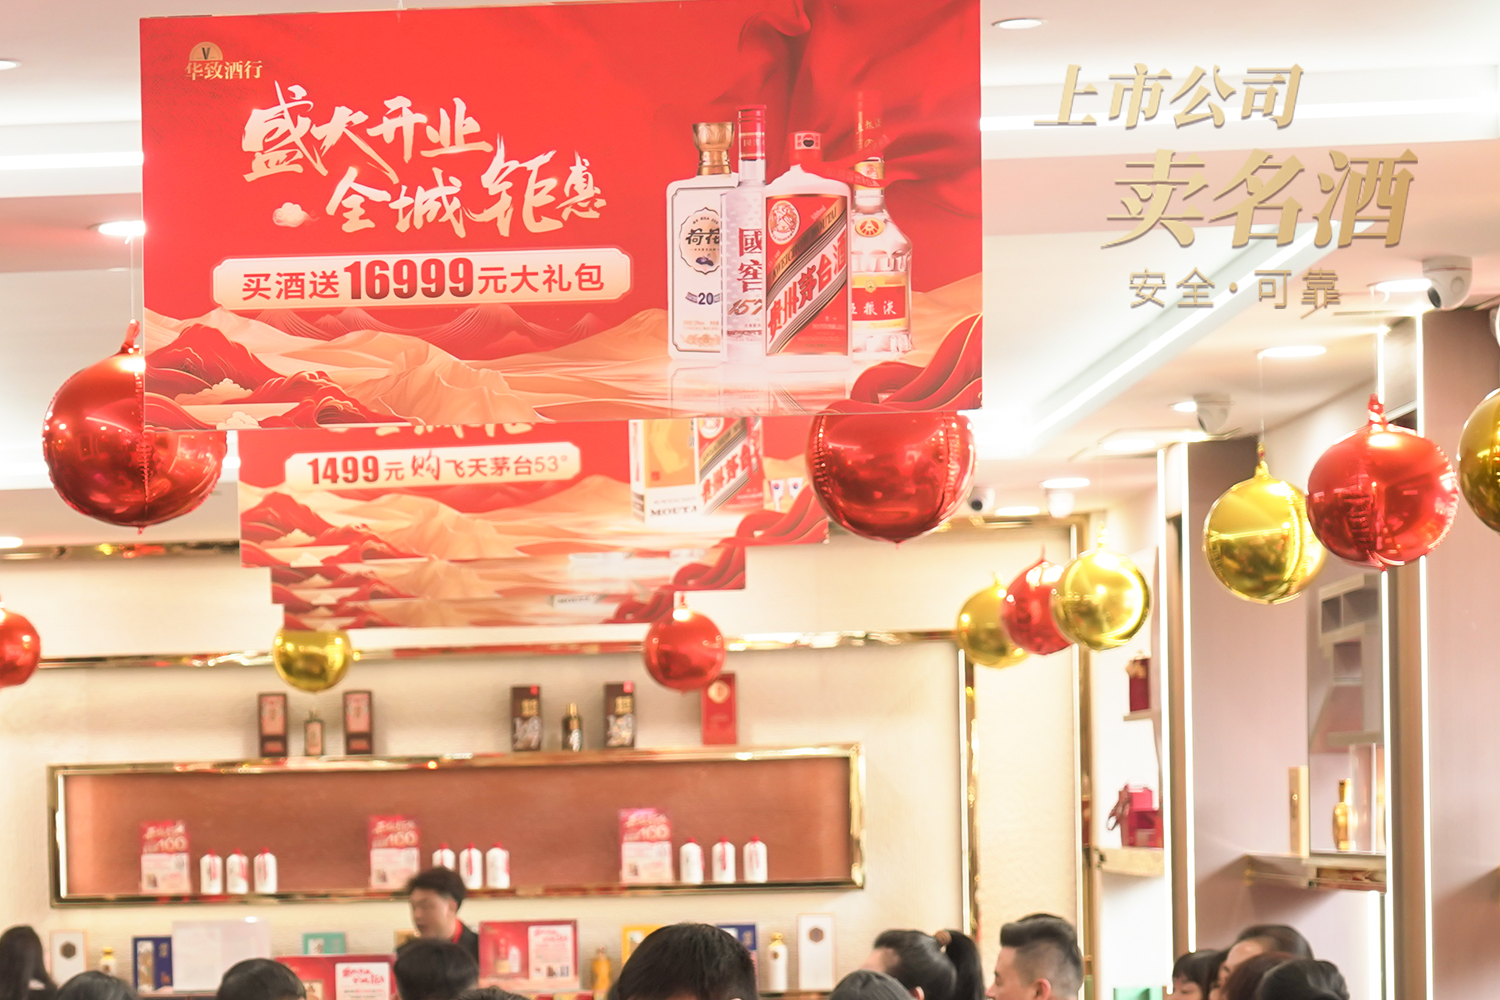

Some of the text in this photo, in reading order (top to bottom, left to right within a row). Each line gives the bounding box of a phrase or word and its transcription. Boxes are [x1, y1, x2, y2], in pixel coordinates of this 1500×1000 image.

[184, 61, 263, 81] 华致酒行
[202, 47, 210, 60] V
[1034, 63, 1304, 130] 上市公司
[241, 80, 494, 185] 盛大开业
[325, 133, 607, 238] 全城钜惠
[1100, 148, 1419, 249] 卖名酒
[242, 257, 606, 302] 买酒送16999元大礼包
[698, 292, 714, 305] 20
[1129, 267, 1341, 310] 安全·可靠
